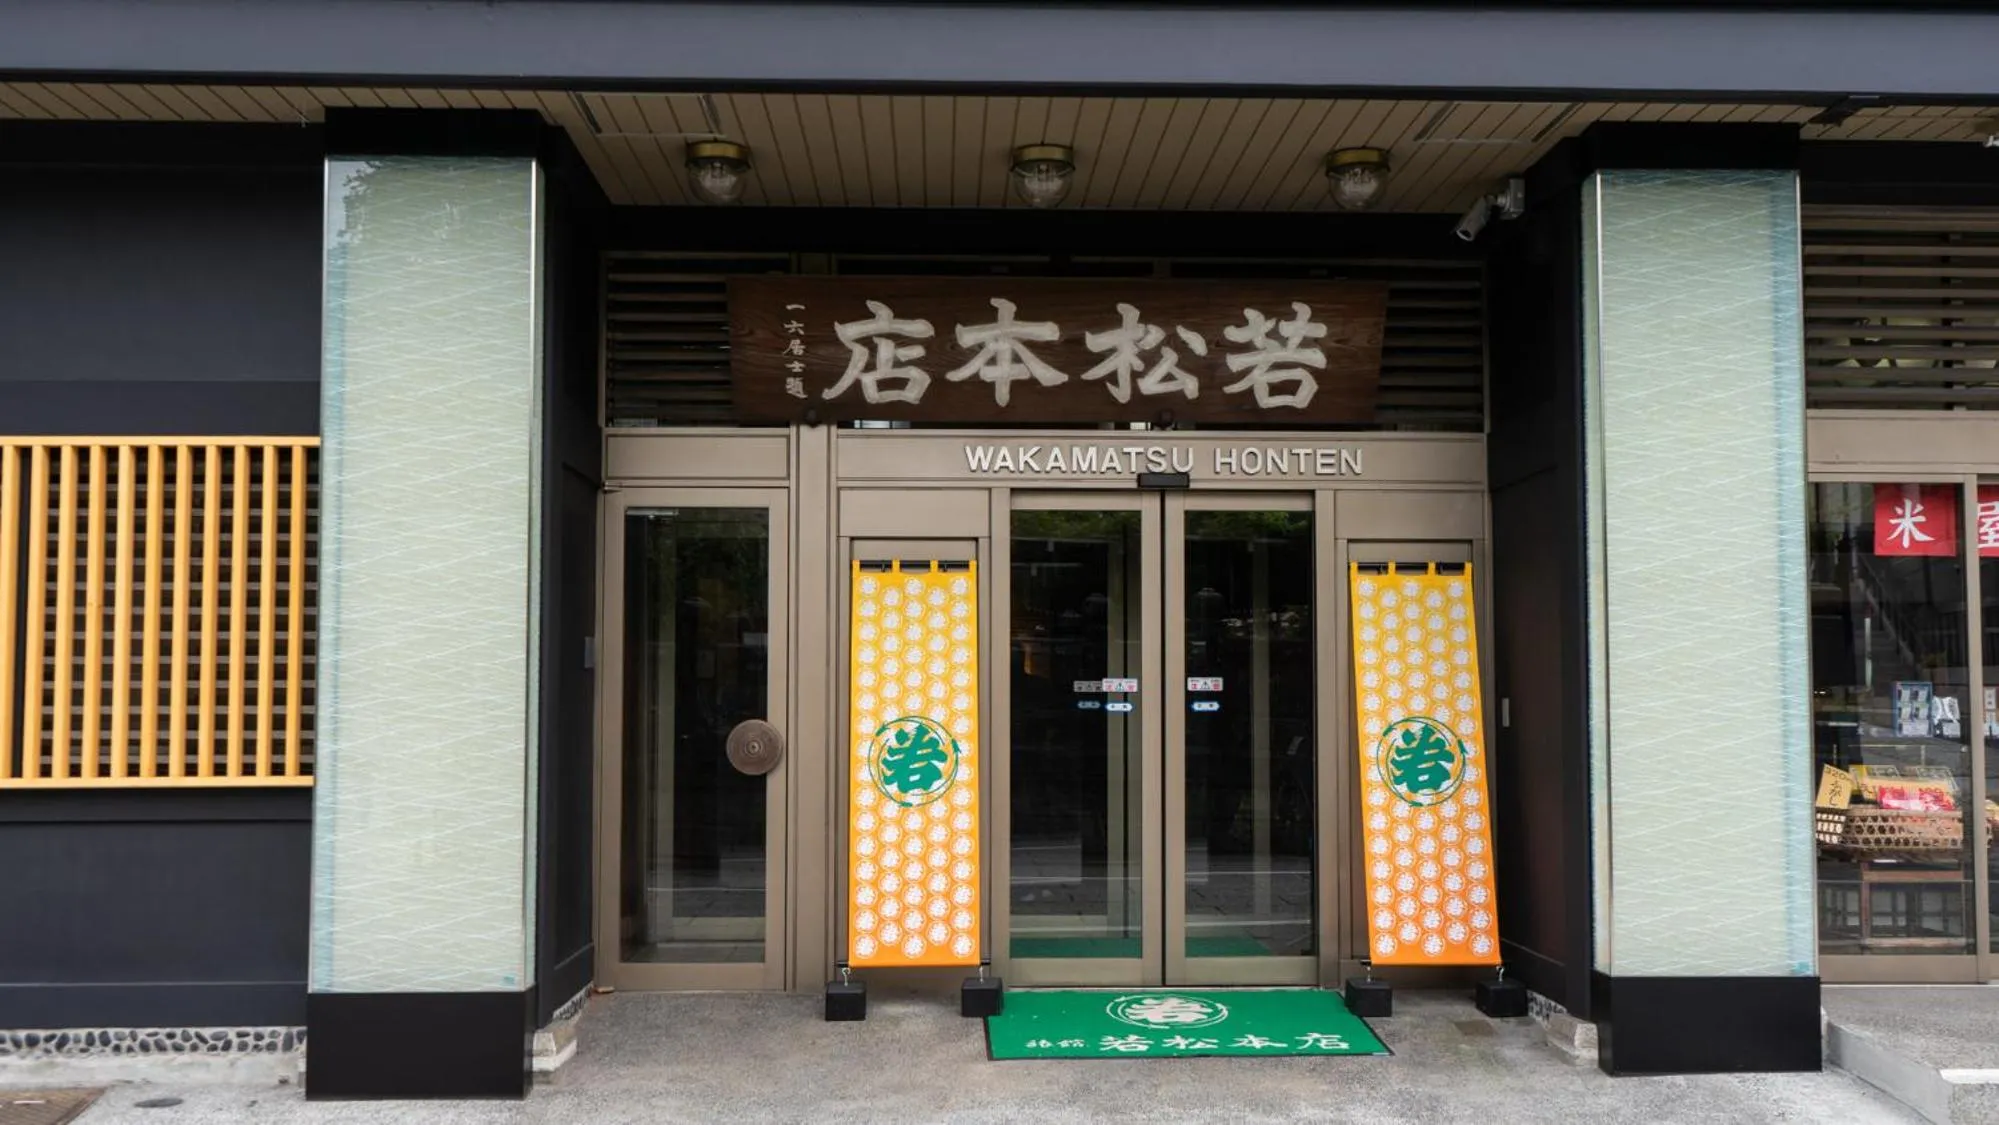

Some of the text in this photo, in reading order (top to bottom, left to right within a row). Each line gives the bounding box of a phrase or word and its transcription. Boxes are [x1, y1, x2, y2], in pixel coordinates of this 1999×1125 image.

[965, 445, 1364, 475] WAKAMATSU HONTEN
[1886, 498, 1935, 549] 米
[1099, 1031, 1350, 1051] 若松本店
